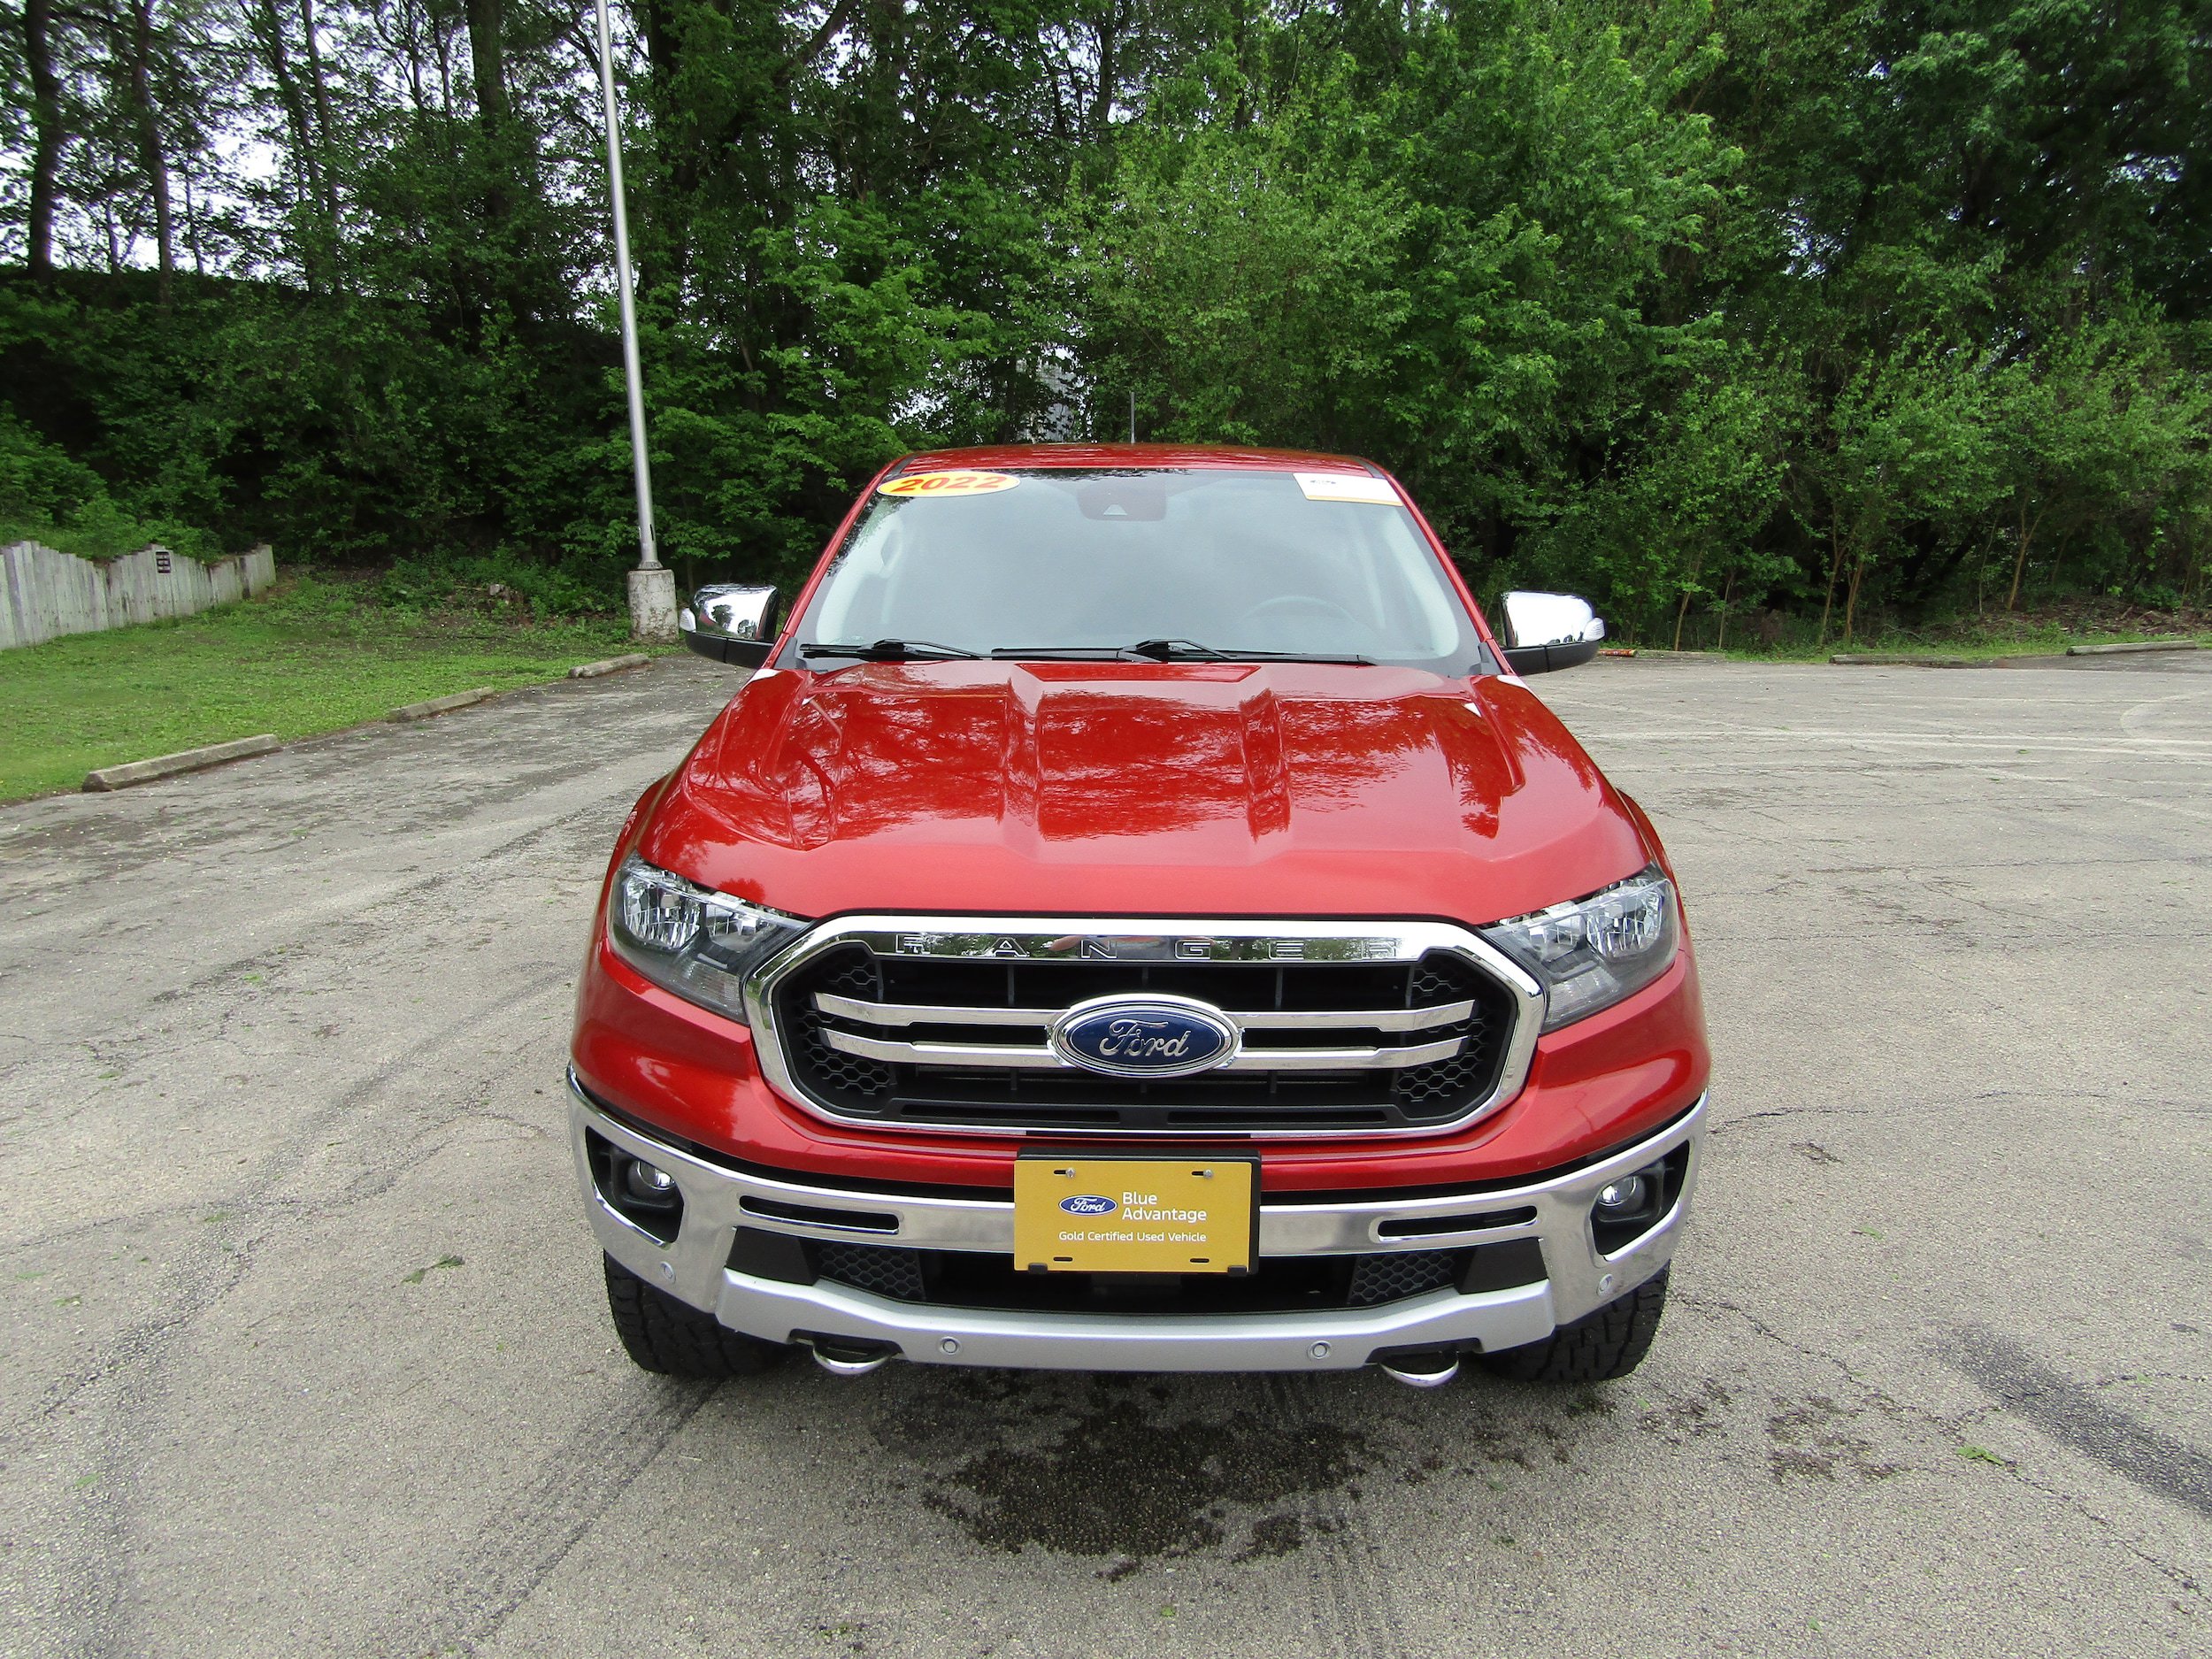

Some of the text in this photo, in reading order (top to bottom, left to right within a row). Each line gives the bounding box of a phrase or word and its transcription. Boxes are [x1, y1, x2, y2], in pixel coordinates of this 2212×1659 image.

[889, 476, 1007, 493] 2022
[895, 933, 1396, 960] RANGER
[1099, 1018, 1192, 1056] Ford
[1070, 1197, 1107, 1212] Ford
[1122, 1192, 1158, 1205] Blue
[1122, 1207, 1207, 1224] Advantage
[1058, 1231, 1207, 1242] Gold Certified Used Vehicle
